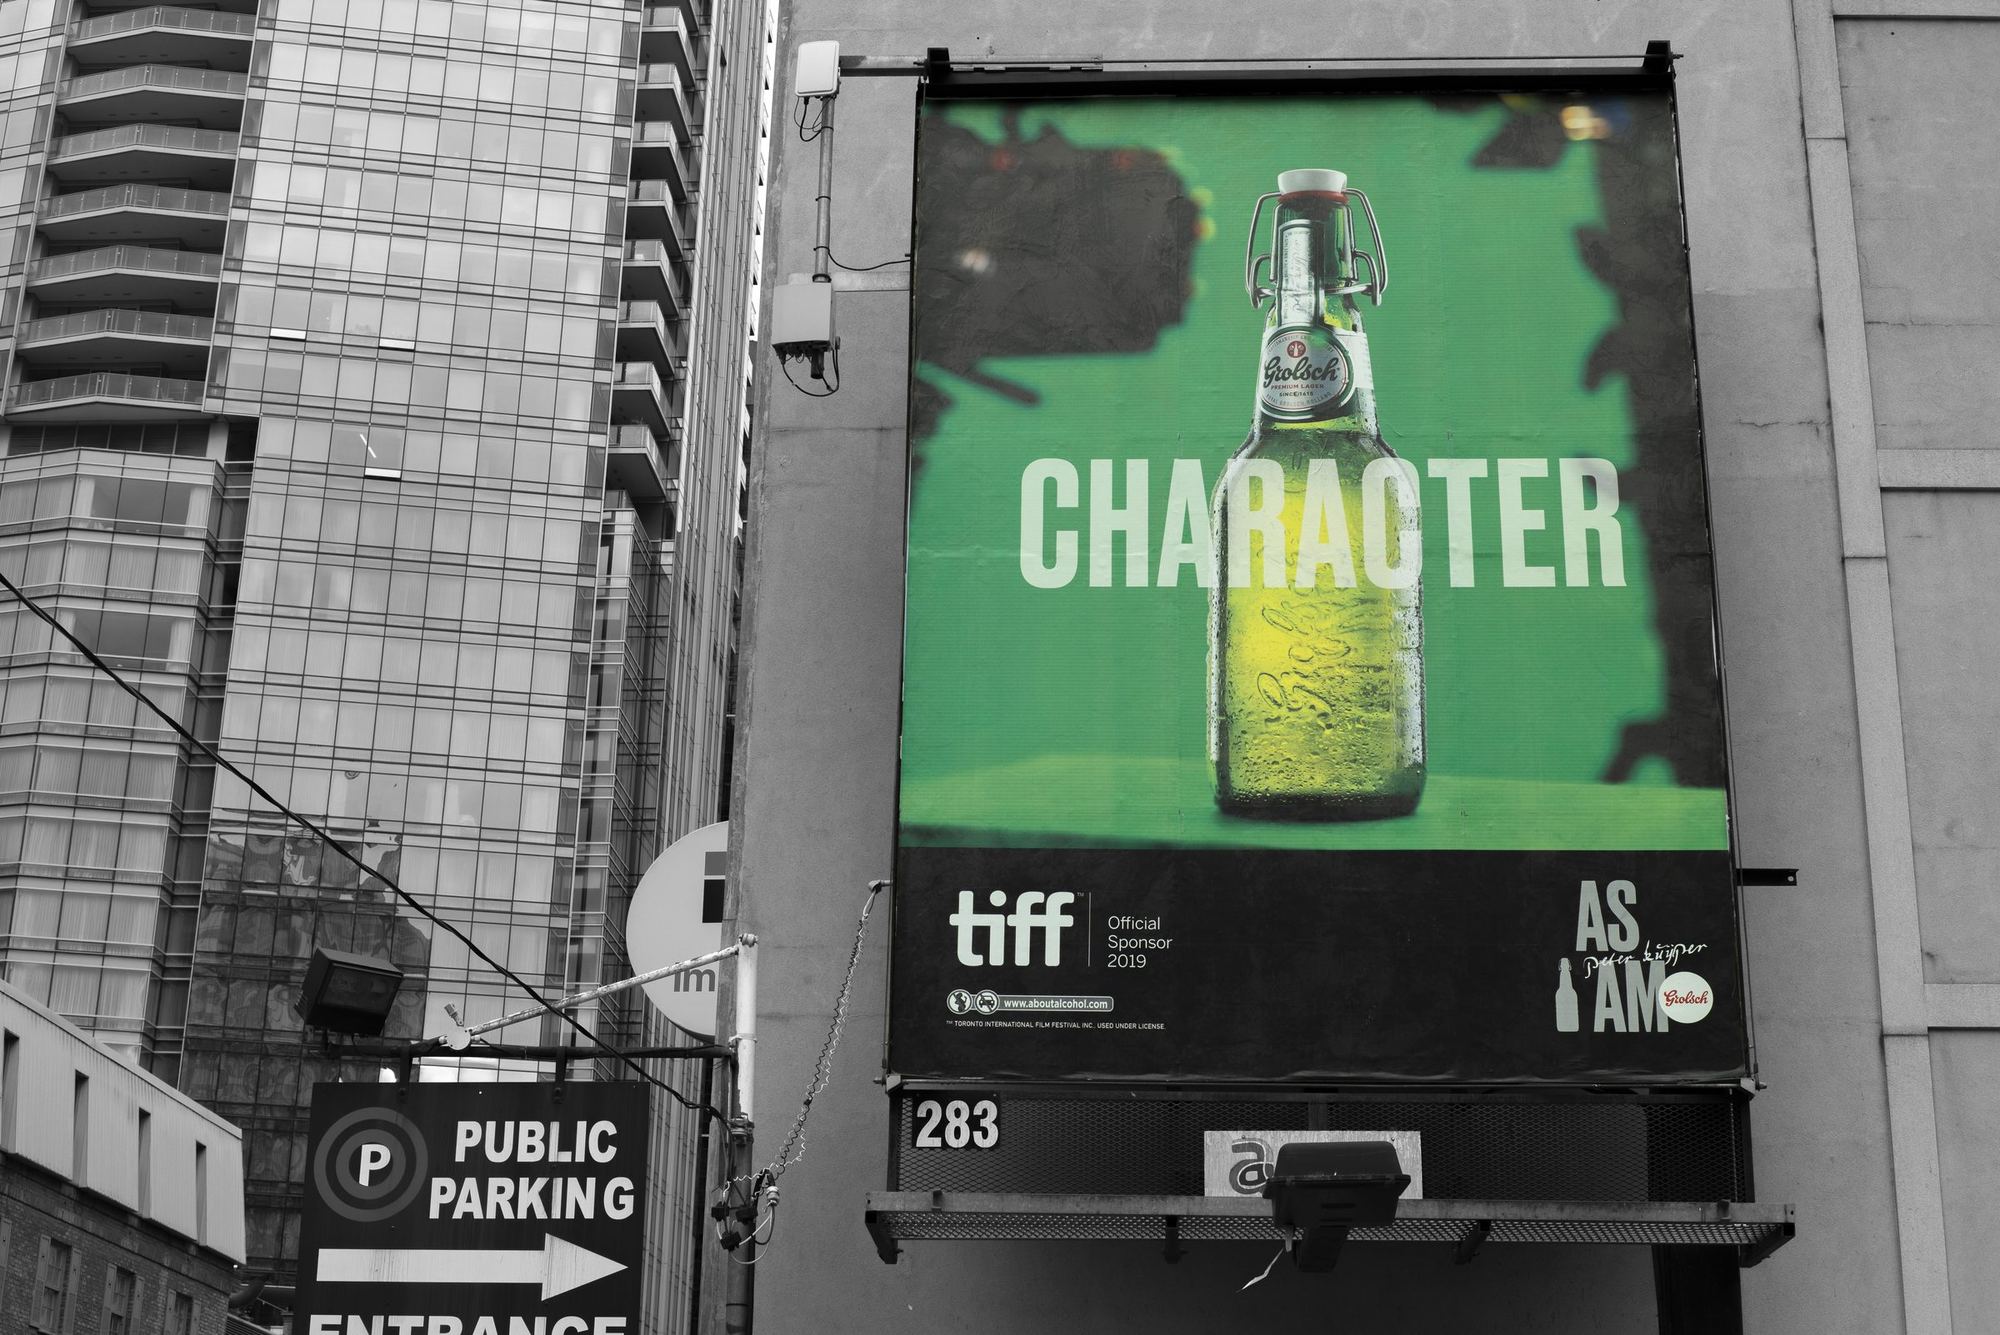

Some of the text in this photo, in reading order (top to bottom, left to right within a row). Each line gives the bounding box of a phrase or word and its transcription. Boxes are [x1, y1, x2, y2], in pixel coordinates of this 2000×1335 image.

[1263, 356, 1338, 388] Grolsch
[1020, 457, 1627, 589] CHARACTER
[949, 890, 1075, 967] tiff
[1108, 916, 1160, 931] Official
[1576, 879, 1640, 952] AS
[1108, 934, 1173, 952] Sponsor
[1108, 953, 1147, 969] 2019
[1004, 998, 1108, 1010] www.aboutalcohol.com
[1593, 959, 1670, 1033] AM
[1663, 989, 1709, 1007] Grolsch
[955, 1020, 984, 1028] TORONTO
[985, 1020, 1034, 1029] INTERNATIONAL
[1036, 1021, 1050, 1029] FILM
[1052, 1021, 1081, 1029] FESTIVAL
[1097, 1022, 1114, 1030] USED
[1115, 1022, 1137, 1030] UNDER
[455, 1120, 617, 1163] PUBLIC
[916, 1100, 998, 1148] 283
[359, 1144, 391, 1187] P
[429, 1176, 634, 1220] PARKING
